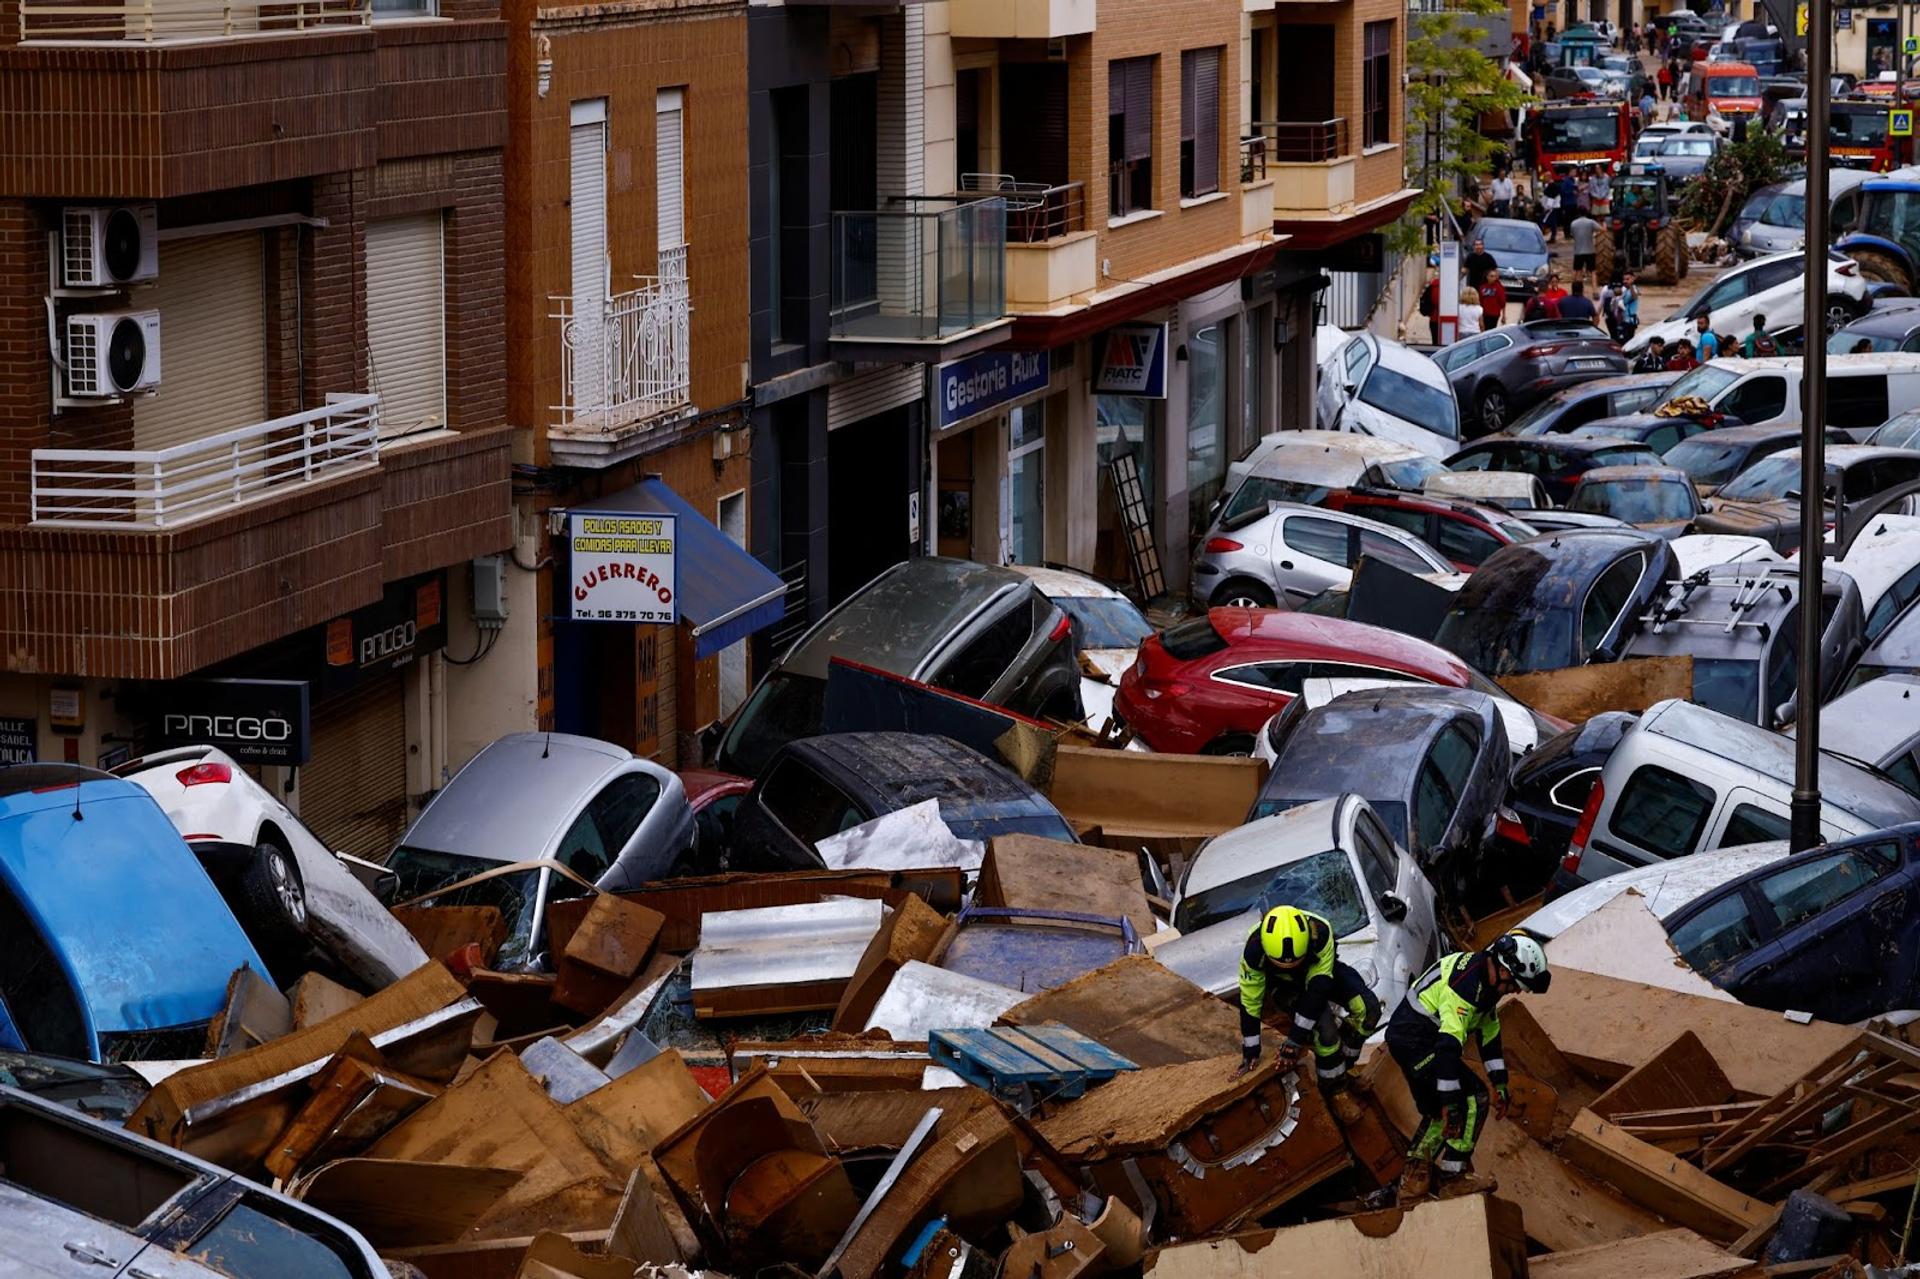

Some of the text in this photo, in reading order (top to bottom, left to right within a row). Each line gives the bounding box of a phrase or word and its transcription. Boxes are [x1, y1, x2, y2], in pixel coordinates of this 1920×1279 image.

[946, 352, 1040, 411] Gestoria Ruix
[1104, 368, 1143, 379] FIATC
[584, 519, 662, 535] POLLOS ASADOS Y
[574, 537, 672, 554] COMIDAS PARA LLEVAR
[575, 563, 672, 603] GUERRERO
[576, 609, 594, 618] Tel.
[640, 611, 654, 620] 70
[657, 612, 671, 620] 76
[360, 620, 415, 664] PREGO
[0, 721, 24, 732] ALLE
[164, 714, 291, 740] PREGO
[0, 734, 32, 746] SABEL
[240, 747, 288, 756] coffee & drink
